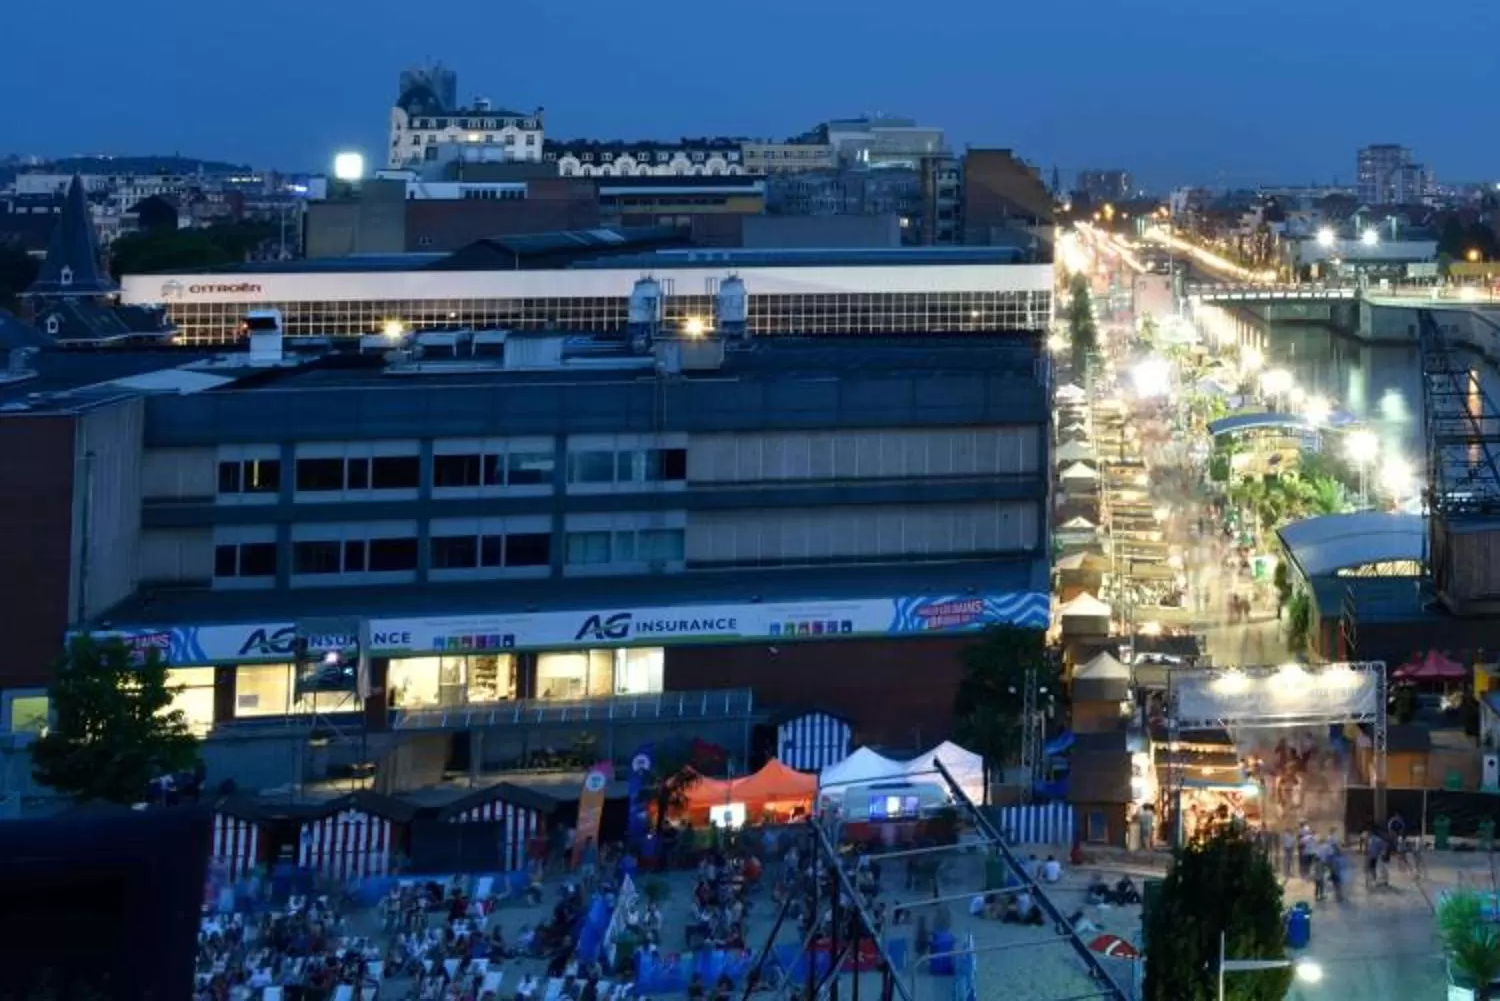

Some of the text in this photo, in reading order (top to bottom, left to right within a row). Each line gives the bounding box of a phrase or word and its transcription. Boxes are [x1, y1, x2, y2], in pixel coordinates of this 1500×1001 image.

[574, 612, 737, 640] AG INSURANCE
[238, 626, 300, 655] AG
